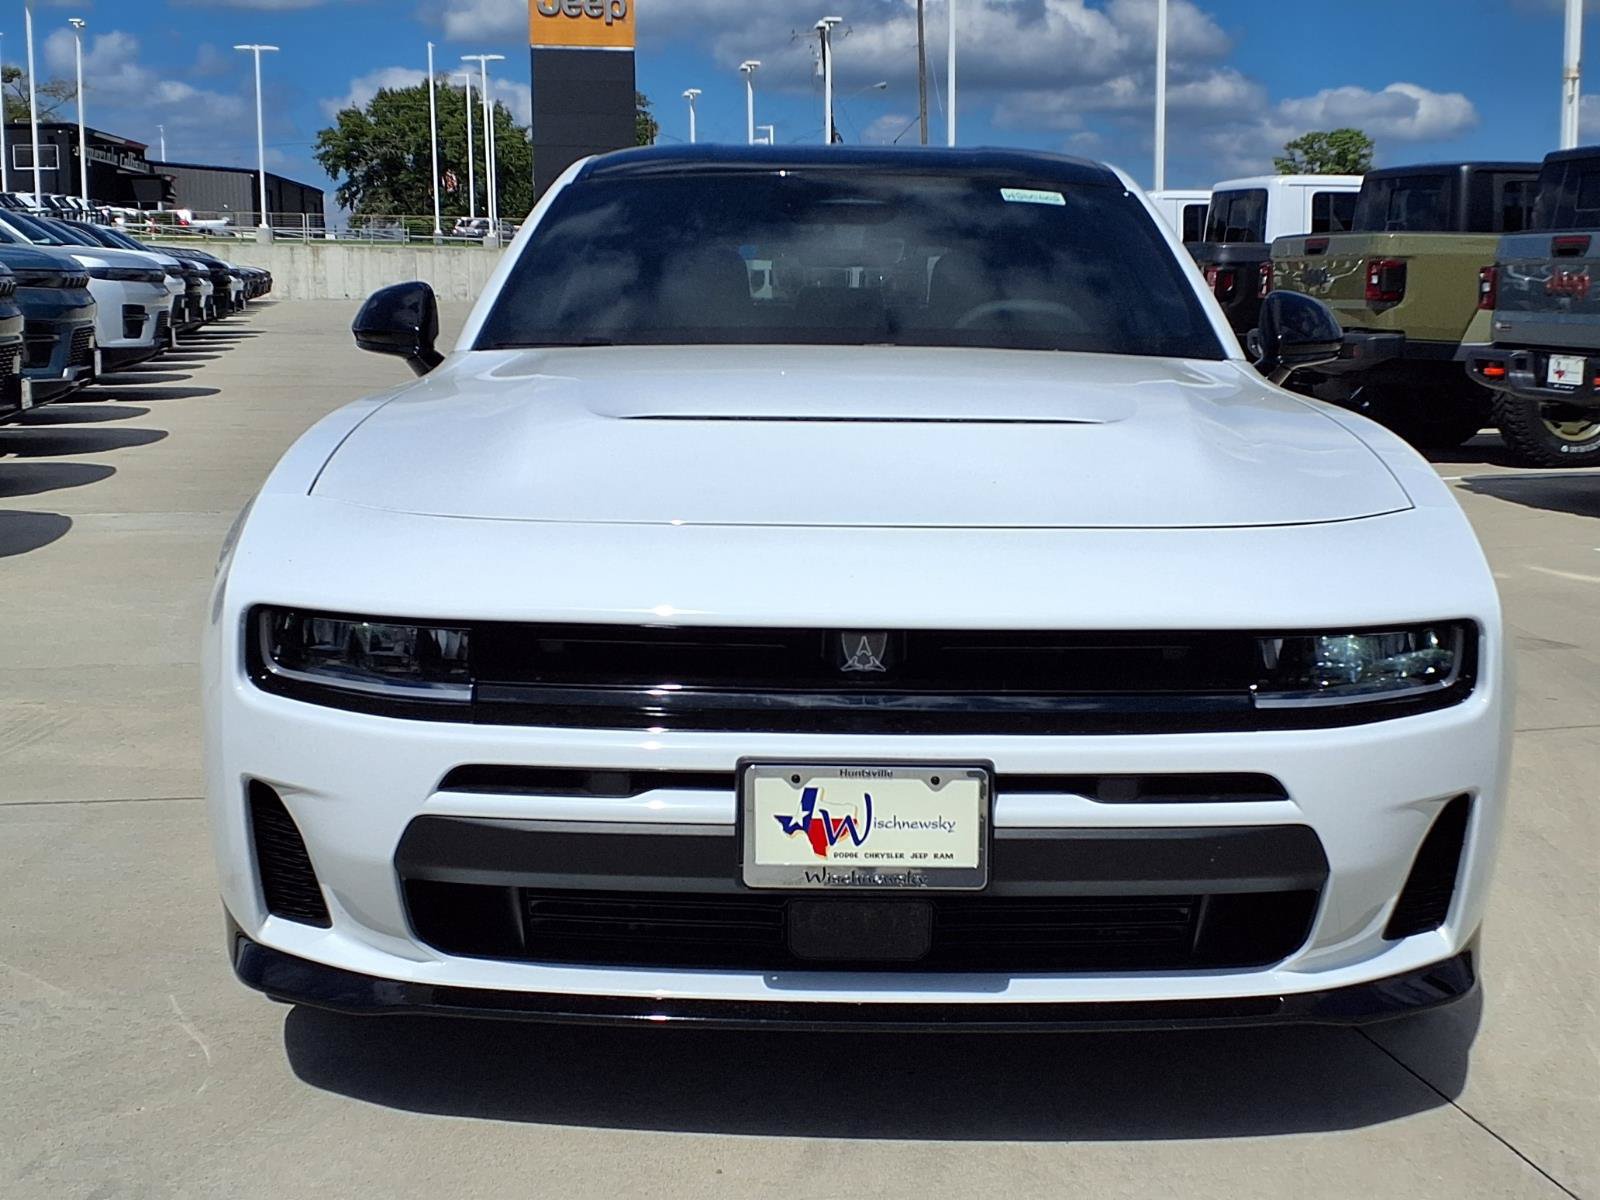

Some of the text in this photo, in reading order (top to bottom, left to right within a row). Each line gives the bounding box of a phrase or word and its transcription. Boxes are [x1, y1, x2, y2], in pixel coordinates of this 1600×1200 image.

[538, 0, 627, 26] Jeep
[839, 768, 894, 778] Huntsville
[818, 792, 957, 847] Wischnewsky
[833, 851, 859, 859] DODGE
[910, 852, 928, 860] JEEP
[933, 852, 954, 860] RAM
